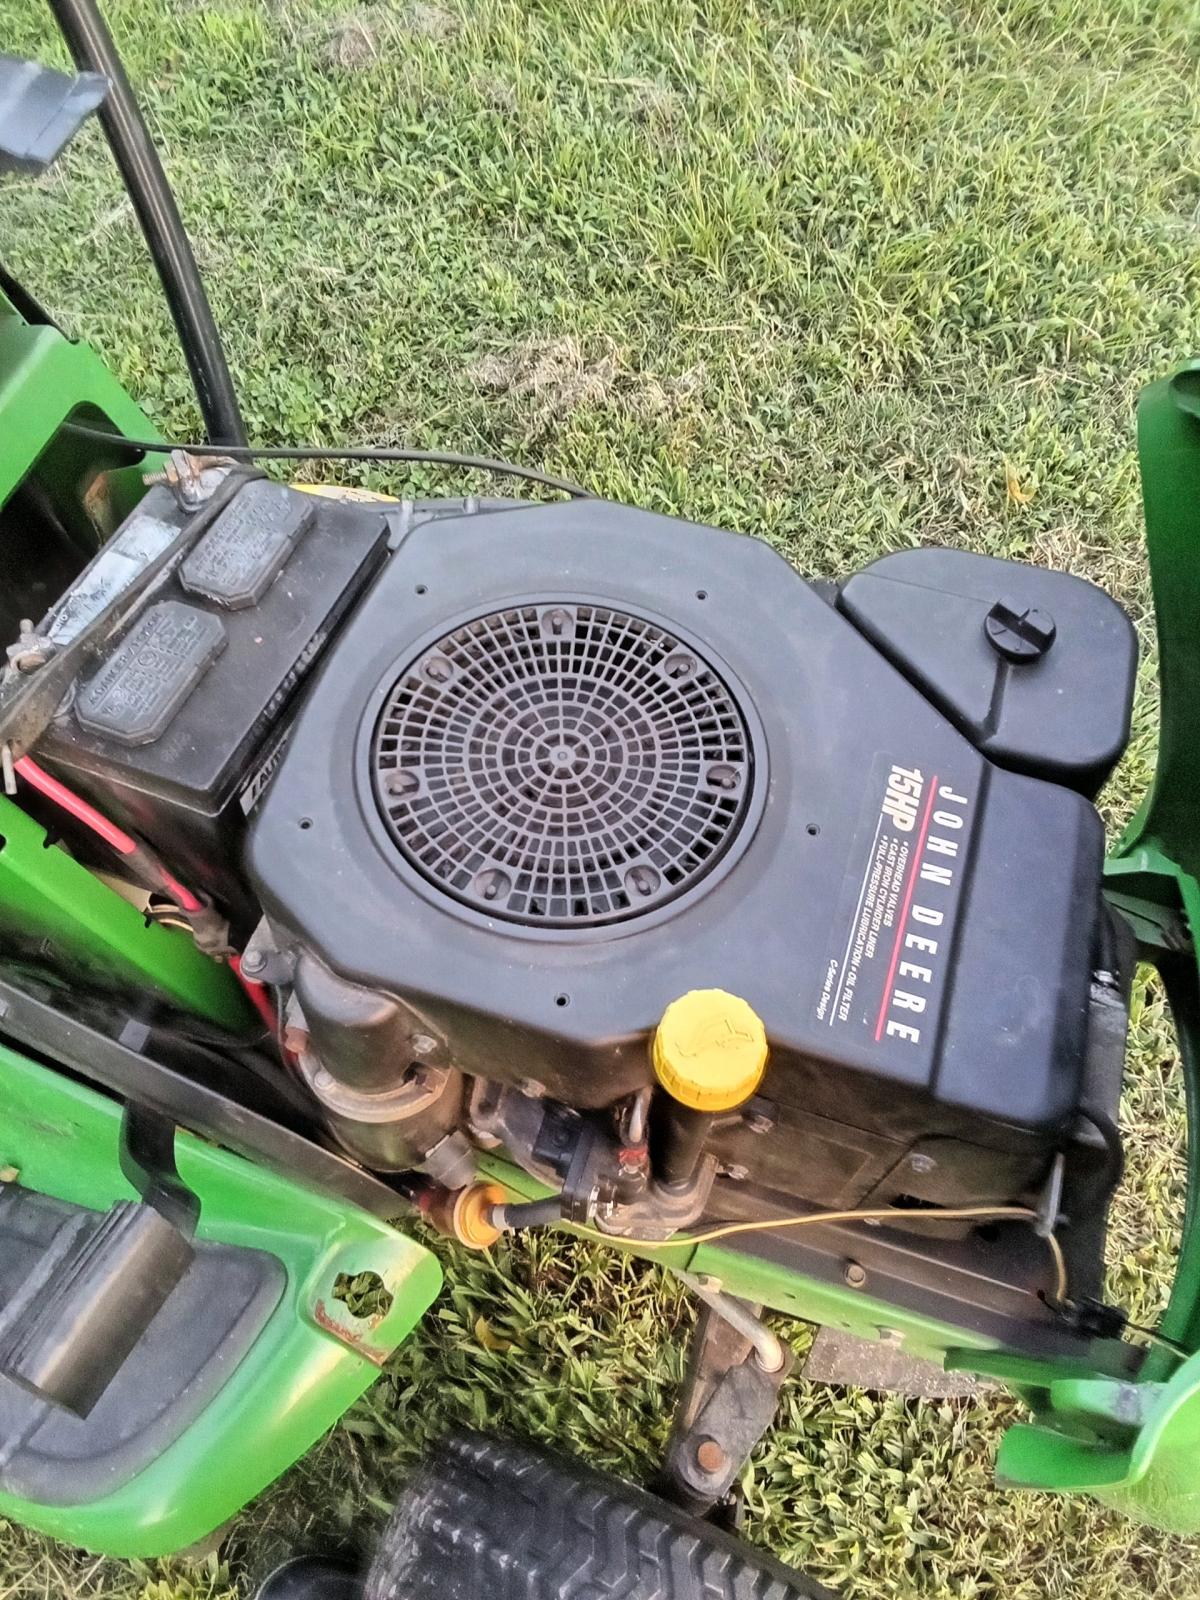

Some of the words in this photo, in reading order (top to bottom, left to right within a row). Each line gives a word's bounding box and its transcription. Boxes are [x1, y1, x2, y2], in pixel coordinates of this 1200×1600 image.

[881, 764, 924, 832] 15HP
[919, 785, 968, 886] JOHN
[886, 842, 899, 867] CAST
[890, 846, 909, 893] OVERHEAD
[863, 839, 889, 908] FULL-PRESSURE
[881, 866, 894, 887] IRON
[871, 886, 889, 931] CYLINDER
[882, 892, 899, 927] VALVES
[851, 909, 873, 967] LUBRICATION
[864, 932, 880, 959] LINER
[824, 959, 839, 991] C-Series
[846, 971, 857, 990] OIL
[886, 904, 944, 1043] DEERE
[816, 991, 831, 1021] Design
[837, 988, 854, 1021] FILTER
